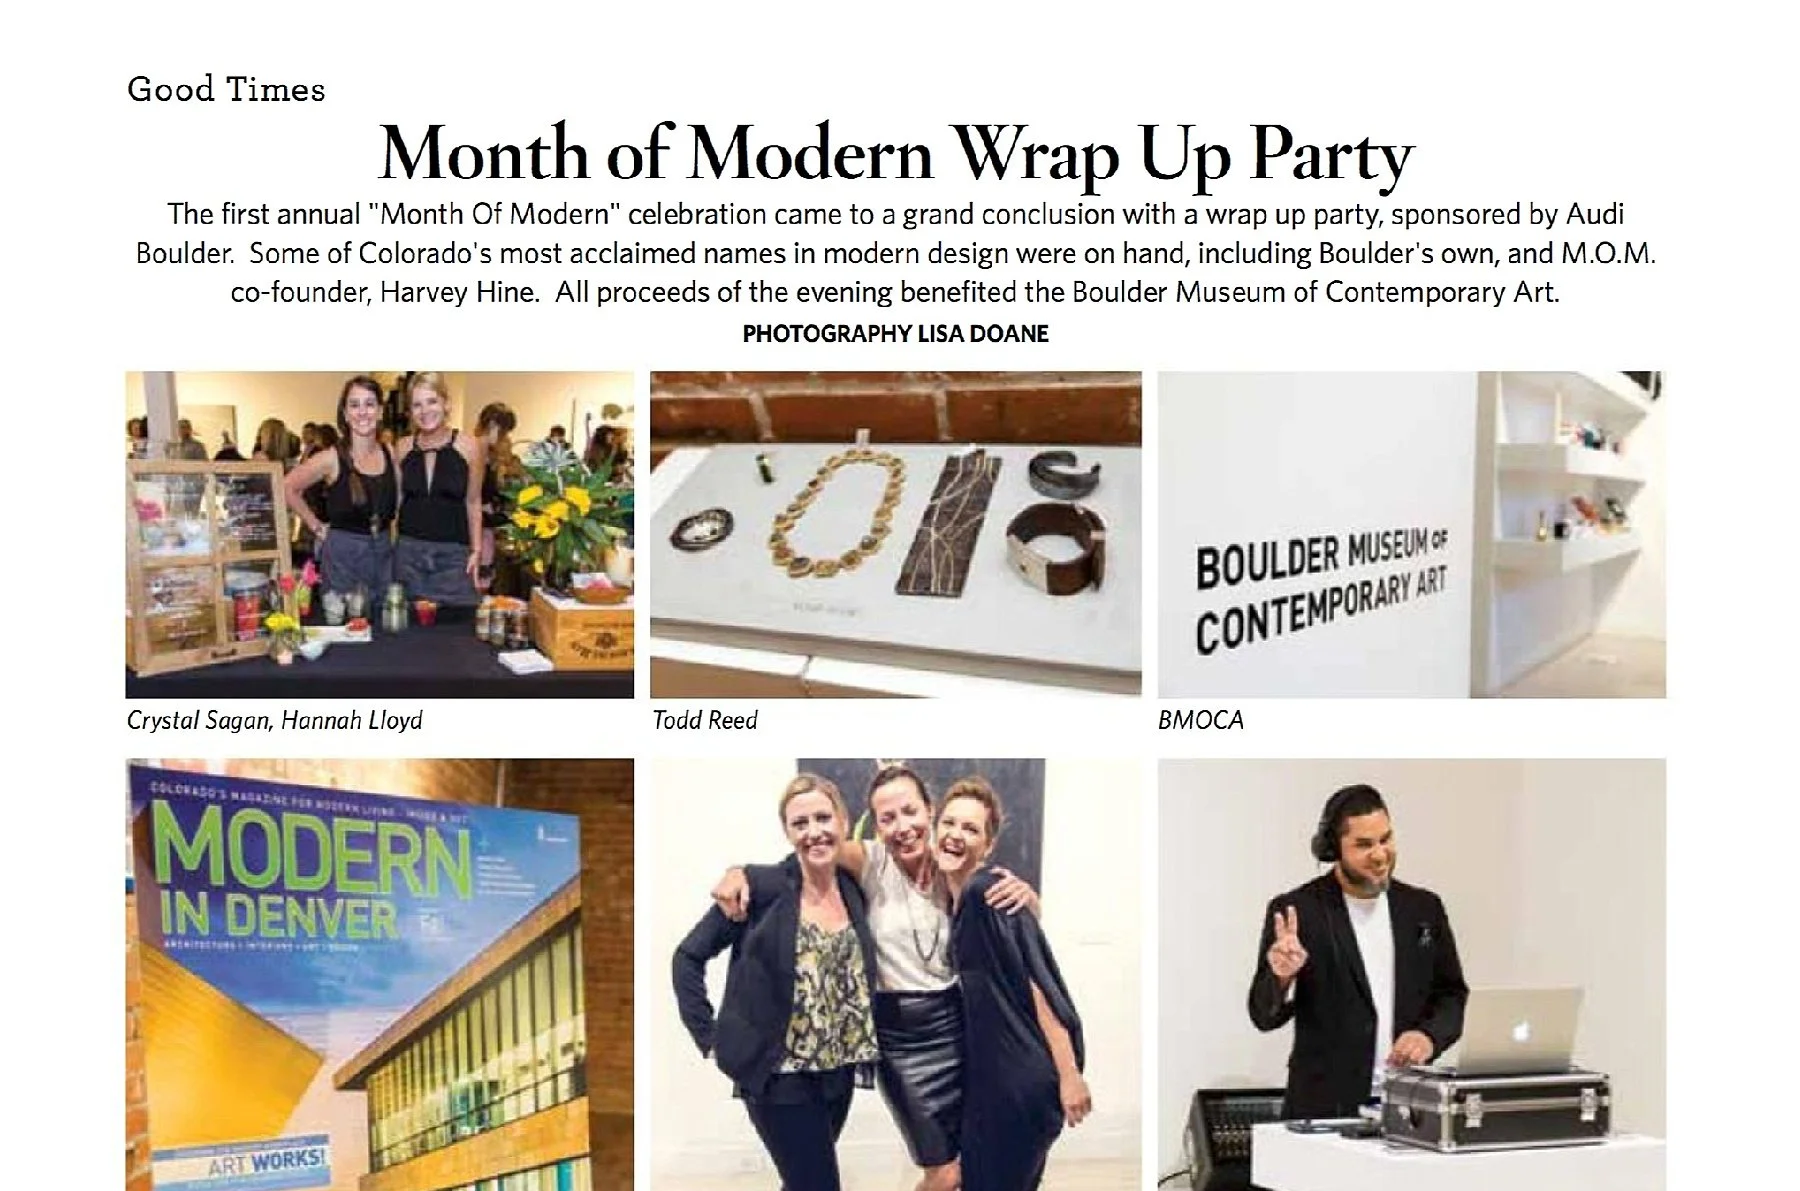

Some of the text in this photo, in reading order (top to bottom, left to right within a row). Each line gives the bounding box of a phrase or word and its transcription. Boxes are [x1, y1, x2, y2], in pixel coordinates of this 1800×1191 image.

[127, 72, 326, 102] Good Times
[377, 118, 1417, 198] Month of Modern Wrap Up Party
[167, 201, 1624, 230] The first annual "Month Of Modern" celebration came to a grand conclusion with a wrap up party, sponsored by Audi
[137, 240, 1656, 270] Boulder. Some of Colorado's most acclaimed names in modern design were on hand, including Boulder's own, and M.O.M.
[231, 279, 1560, 308] co-founder, Harvey Hine. All proceeds of the evening benefited the Boulder Museum of Contemporary Art.
[743, 323, 1050, 343] PHOTOGRAPHY LISA DOANE
[1197, 527, 1450, 590] BOULDER MUSEUM OF
[1196, 565, 1449, 656] CONTEMPORARY ART
[127, 709, 424, 734] Crystal Sagan, Hannah Lloyd
[653, 709, 759, 730] Todd Reed
[1158, 709, 1244, 730] BMOCA
[152, 799, 472, 900] MODERN
[160, 889, 400, 940] IN DENVER
[208, 1148, 325, 1177] ART WORKS!
